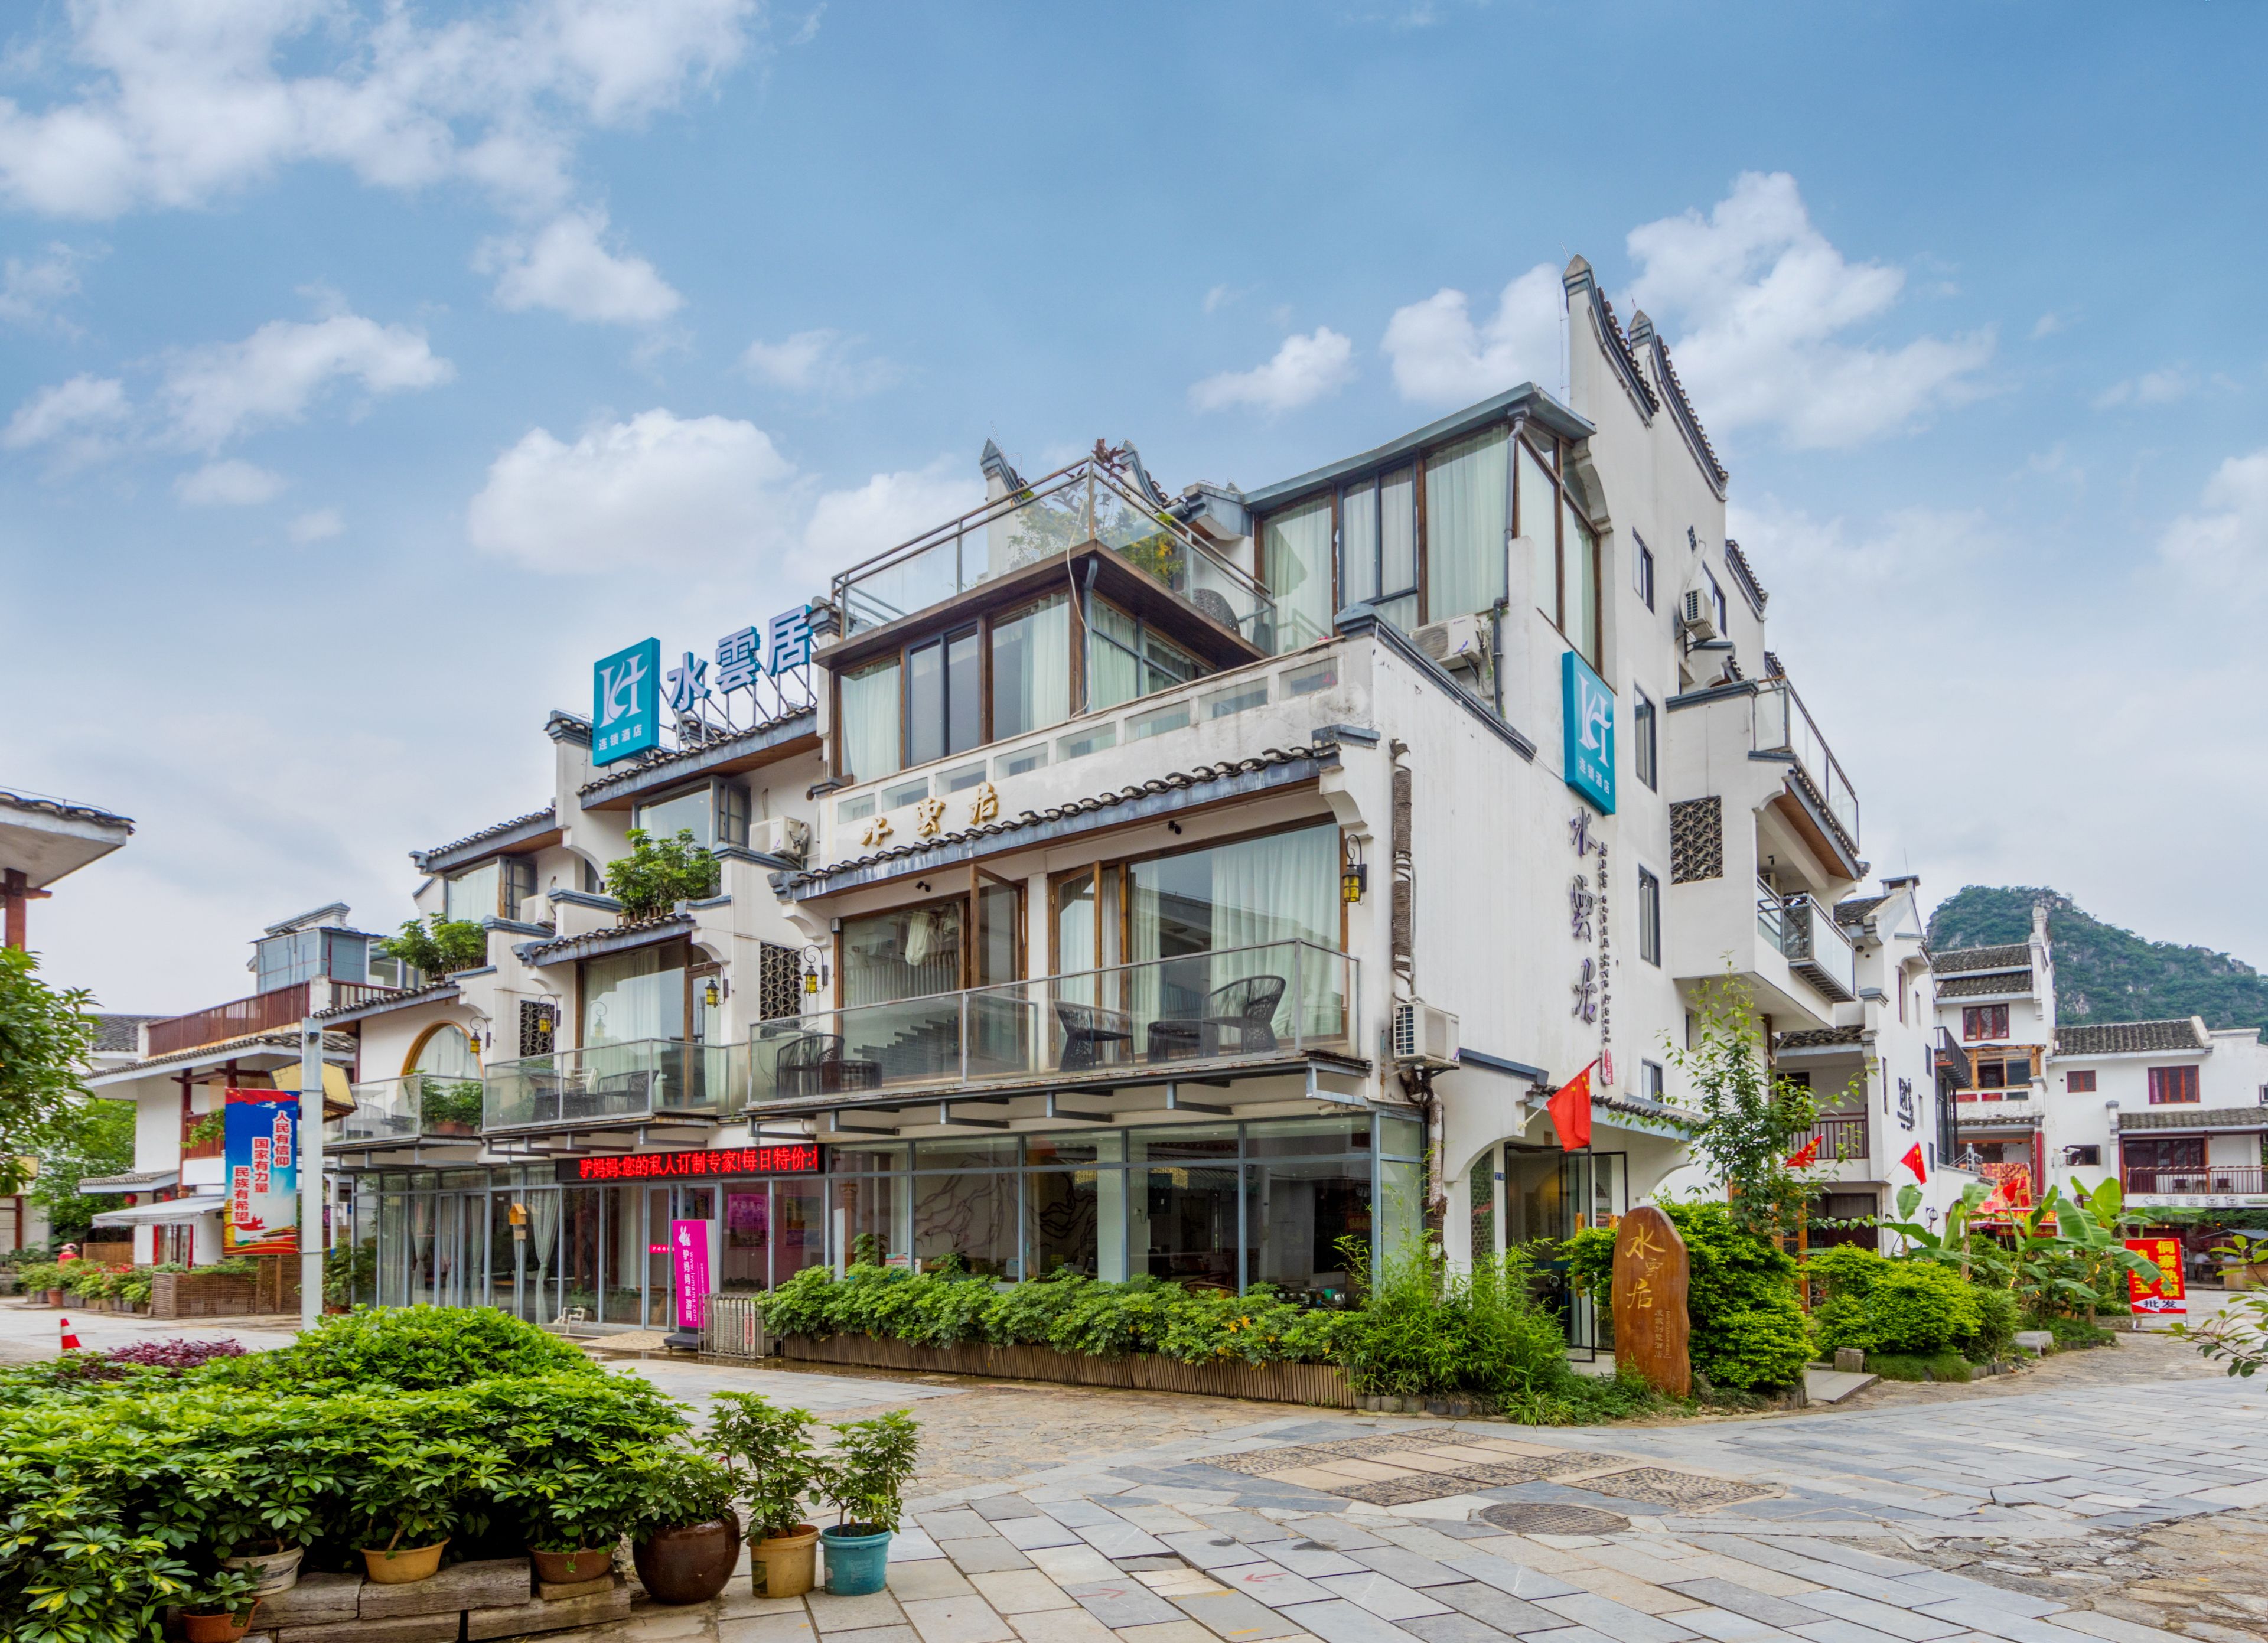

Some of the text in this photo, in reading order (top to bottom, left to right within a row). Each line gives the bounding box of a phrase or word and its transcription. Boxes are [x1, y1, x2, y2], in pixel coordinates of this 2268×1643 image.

[667, 605, 813, 713] 水雲居
[598, 724, 642, 751] 连锁酒店
[254, 1139, 269, 1193] 国家有力量
[274, 1111, 290, 1167] 人民有信仰
[234, 1167, 250, 1222] 民族有希望
[682, 1249, 692, 1322] 驴妈妈旅游网
[2143, 1300, 2177, 1308] 批发
